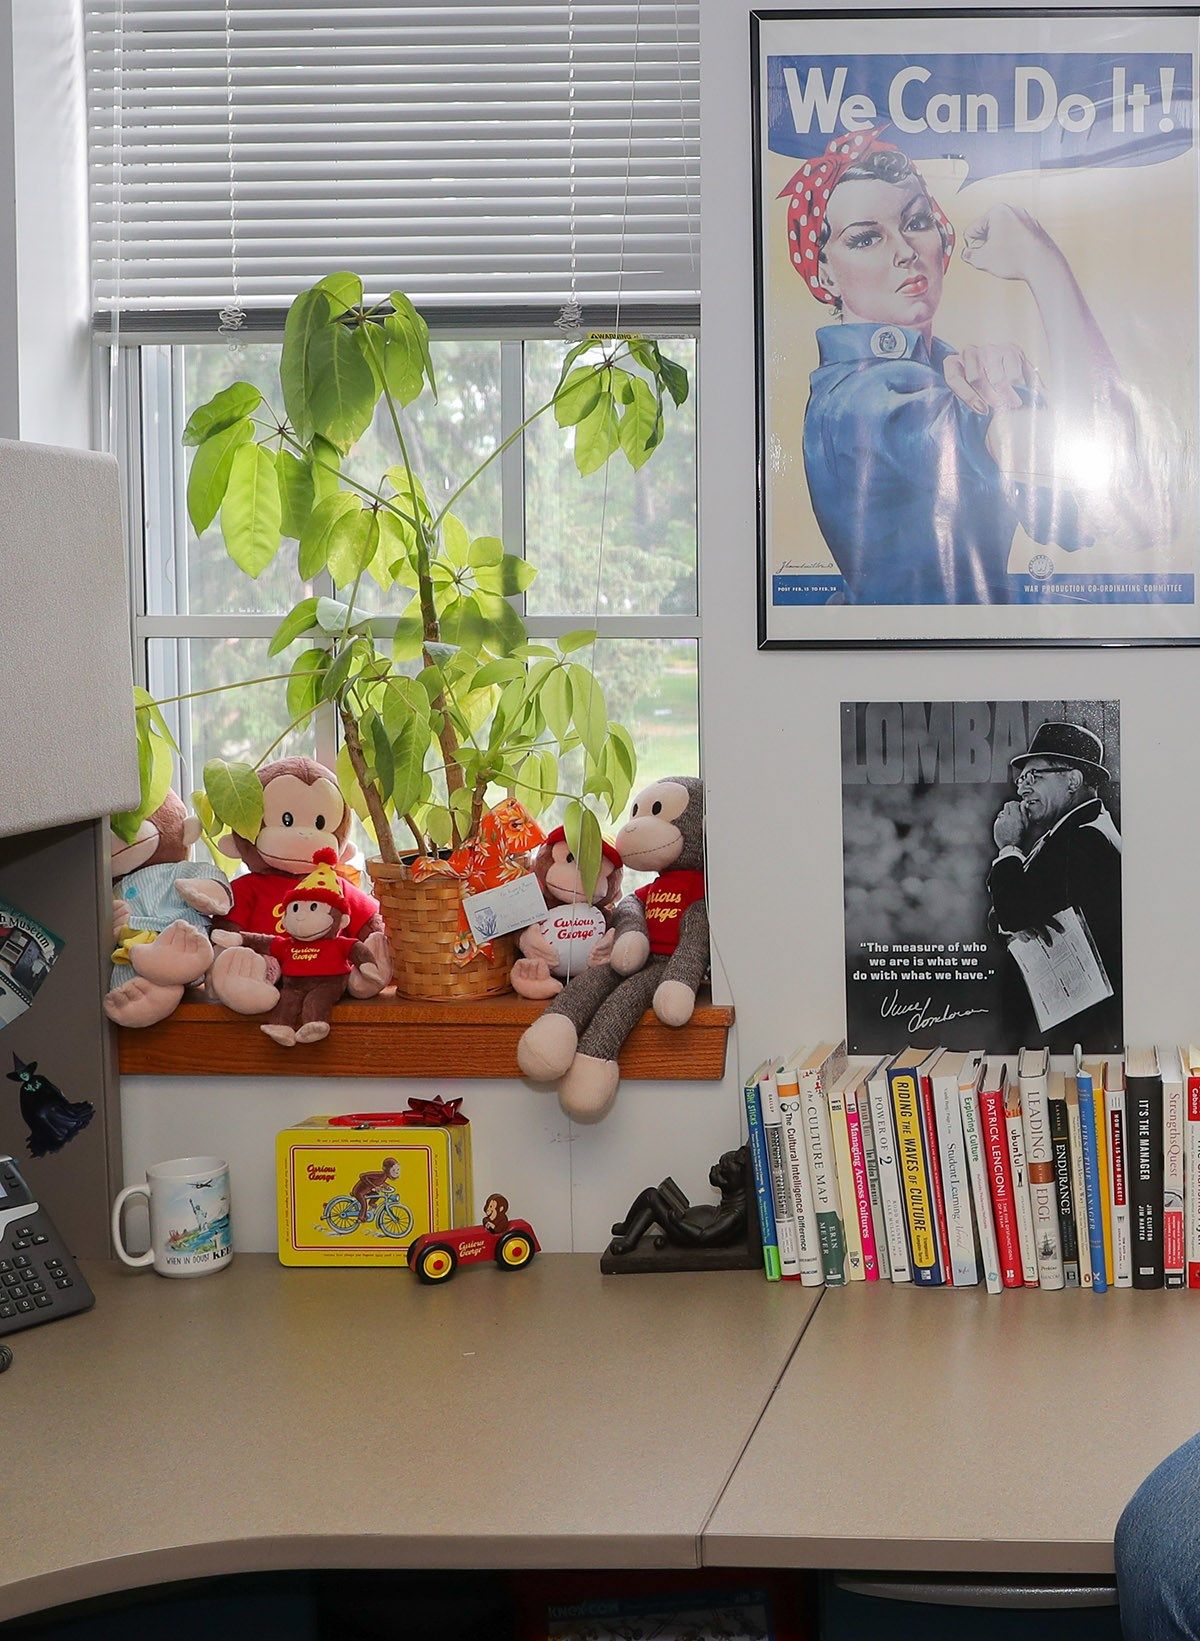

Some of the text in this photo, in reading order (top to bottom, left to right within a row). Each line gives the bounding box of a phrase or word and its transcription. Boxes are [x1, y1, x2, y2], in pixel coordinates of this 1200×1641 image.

[783, 66, 1176, 134] We Can Do It!
[1024, 584, 1183, 593] WAR PRODUCTION CO-ORDINATING COMMITTEE
[9, 917, 50, 950] Museum
[554, 917, 594, 928] Curious
[557, 929, 594, 941] George
[860, 942, 987, 953] “The measure of who
[869, 957, 978, 966] we are is what we
[853, 970, 995, 981] do with what we have.”
[897, 1082, 912, 1117] RIDING
[875, 1097, 892, 1166] POWER OF 2
[902, 1121, 911, 1134] THE
[964, 1097, 979, 1162] Exploring Culture
[1028, 1091, 1045, 1159] LEADING
[1139, 1120, 1150, 1136] THE
[1166, 1093, 1180, 1177] StrengthsQuest
[787, 1128, 798, 1161] Cultural
[807, 1106, 824, 1169] CULTURE
[816, 1175, 828, 1204] MAP
[904, 1138, 919, 1172] WAVES
[947, 1144, 957, 1178] Student
[986, 1099, 1006, 1196] PATRICK LENCIONI
[1011, 1129, 1023, 1167] ubuntu!
[1139, 1139, 1150, 1180] MANAGER
[307, 1164, 336, 1173] Curious
[308, 1173, 335, 1182] George
[850, 1123, 870, 1239] Managing Across Cultures
[908, 1175, 918, 1184] OF
[1057, 1144, 1071, 1215] ENDURANCE
[792, 1164, 804, 1213] Intelligence
[951, 1180, 961, 1220] Learning
[1036, 1189, 1050, 1222] EDGE
[910, 1188, 926, 1231] CULTURE
[1086, 1185, 1096, 1230] MANAGER
[459, 1240, 484, 1250] Curious
[798, 1216, 807, 1252] Difference
[820, 1222, 829, 1255] MEYER
[830, 1226, 838, 1249] ERIN
[166, 1257, 181, 1265] WHEN
[183, 1256, 191, 1264] IN
